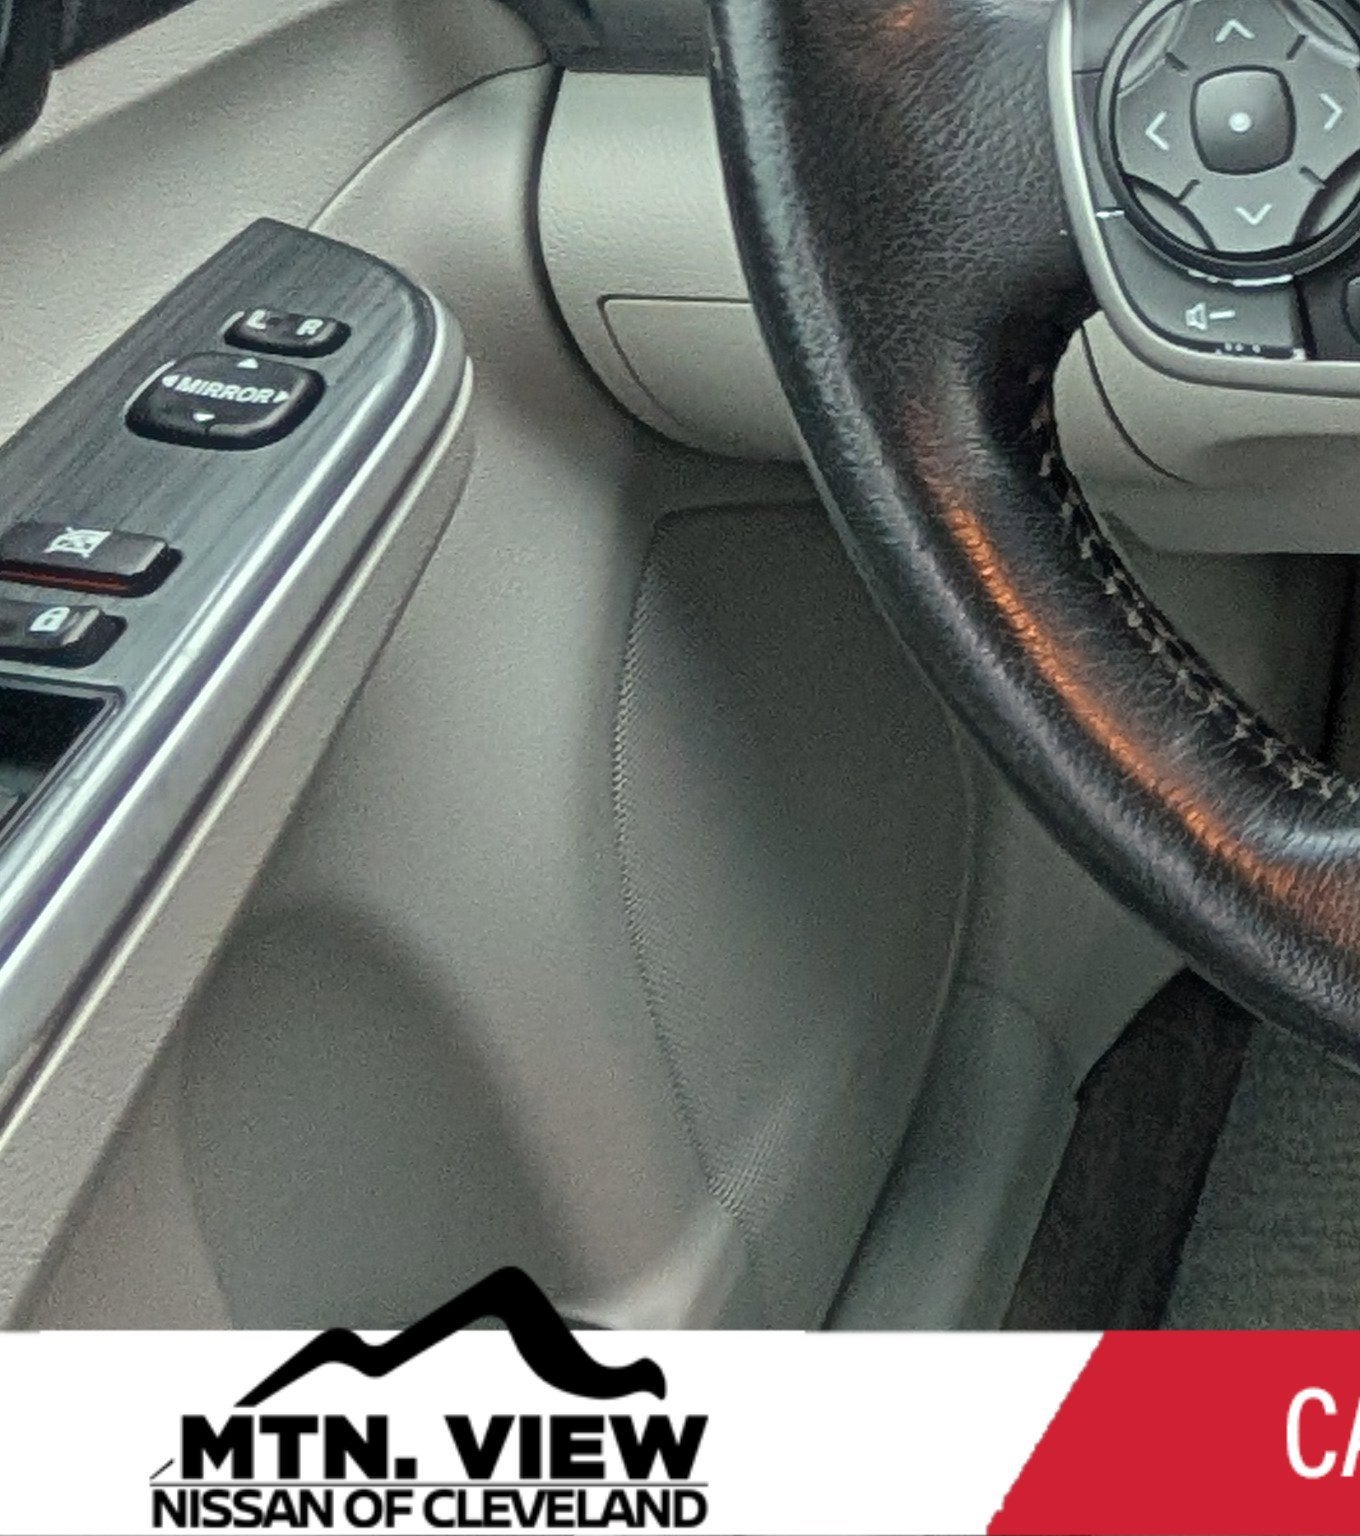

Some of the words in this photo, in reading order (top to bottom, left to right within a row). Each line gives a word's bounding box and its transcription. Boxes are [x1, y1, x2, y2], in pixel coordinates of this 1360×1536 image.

[245, 309, 267, 330] L
[296, 318, 324, 336] R
[174, 375, 276, 404] MIRROR
